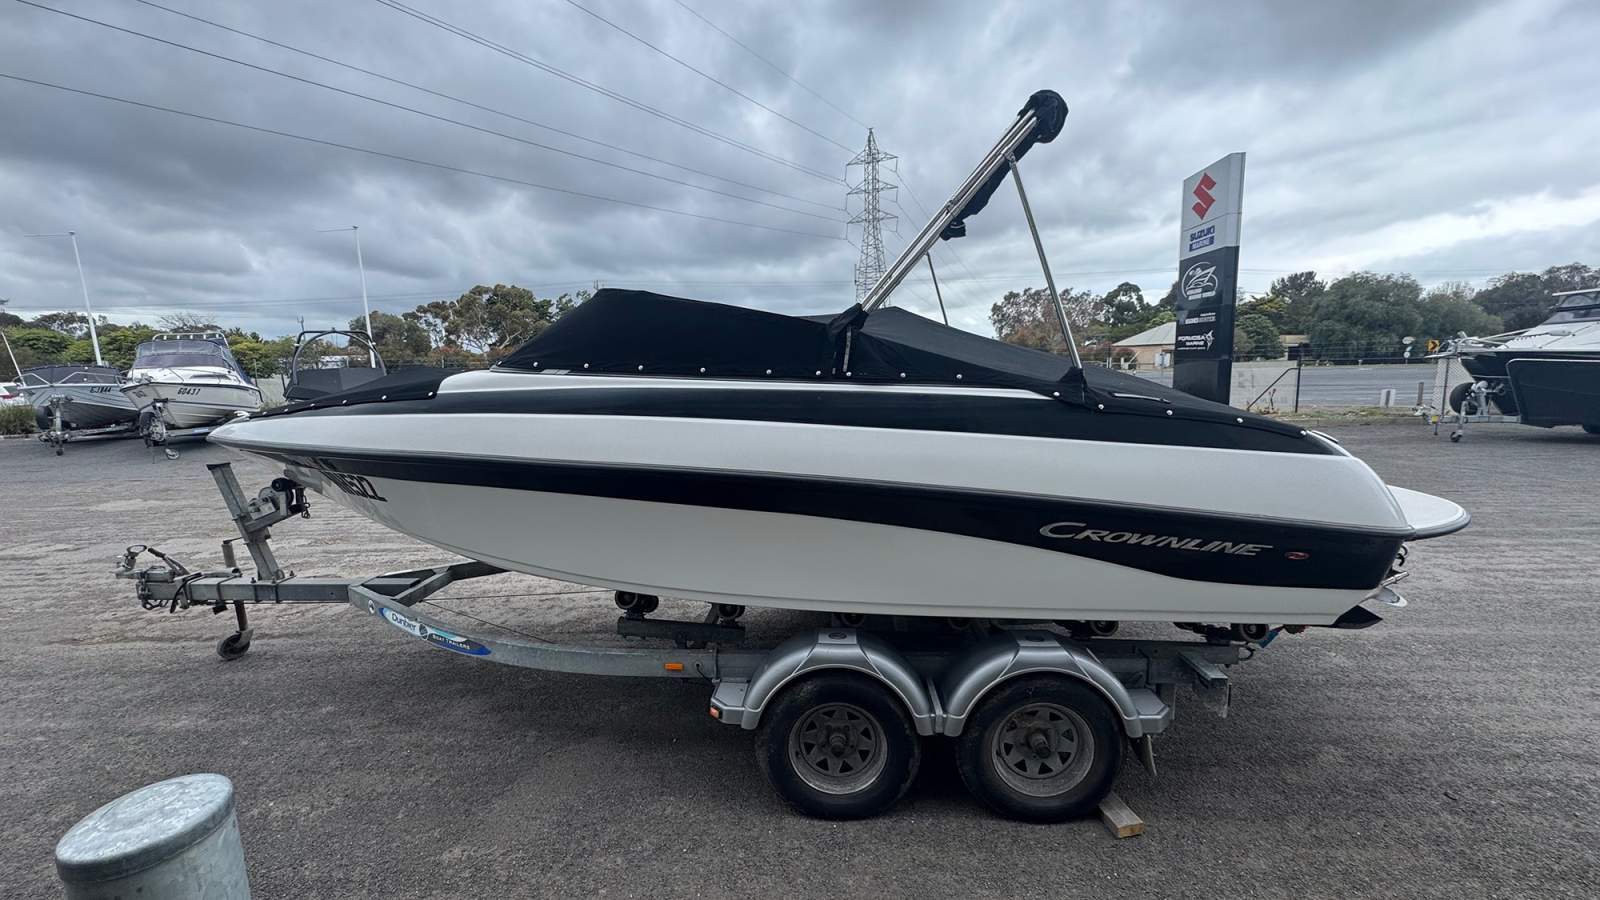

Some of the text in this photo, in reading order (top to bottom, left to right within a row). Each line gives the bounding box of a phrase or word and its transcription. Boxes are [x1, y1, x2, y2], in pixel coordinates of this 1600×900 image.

[1190, 225, 1215, 242] SUZUKI
[1039, 521, 1274, 556] CROWNLINE
[391, 611, 417, 631] Dunbier
[446, 639, 471, 650] TRAILERS
